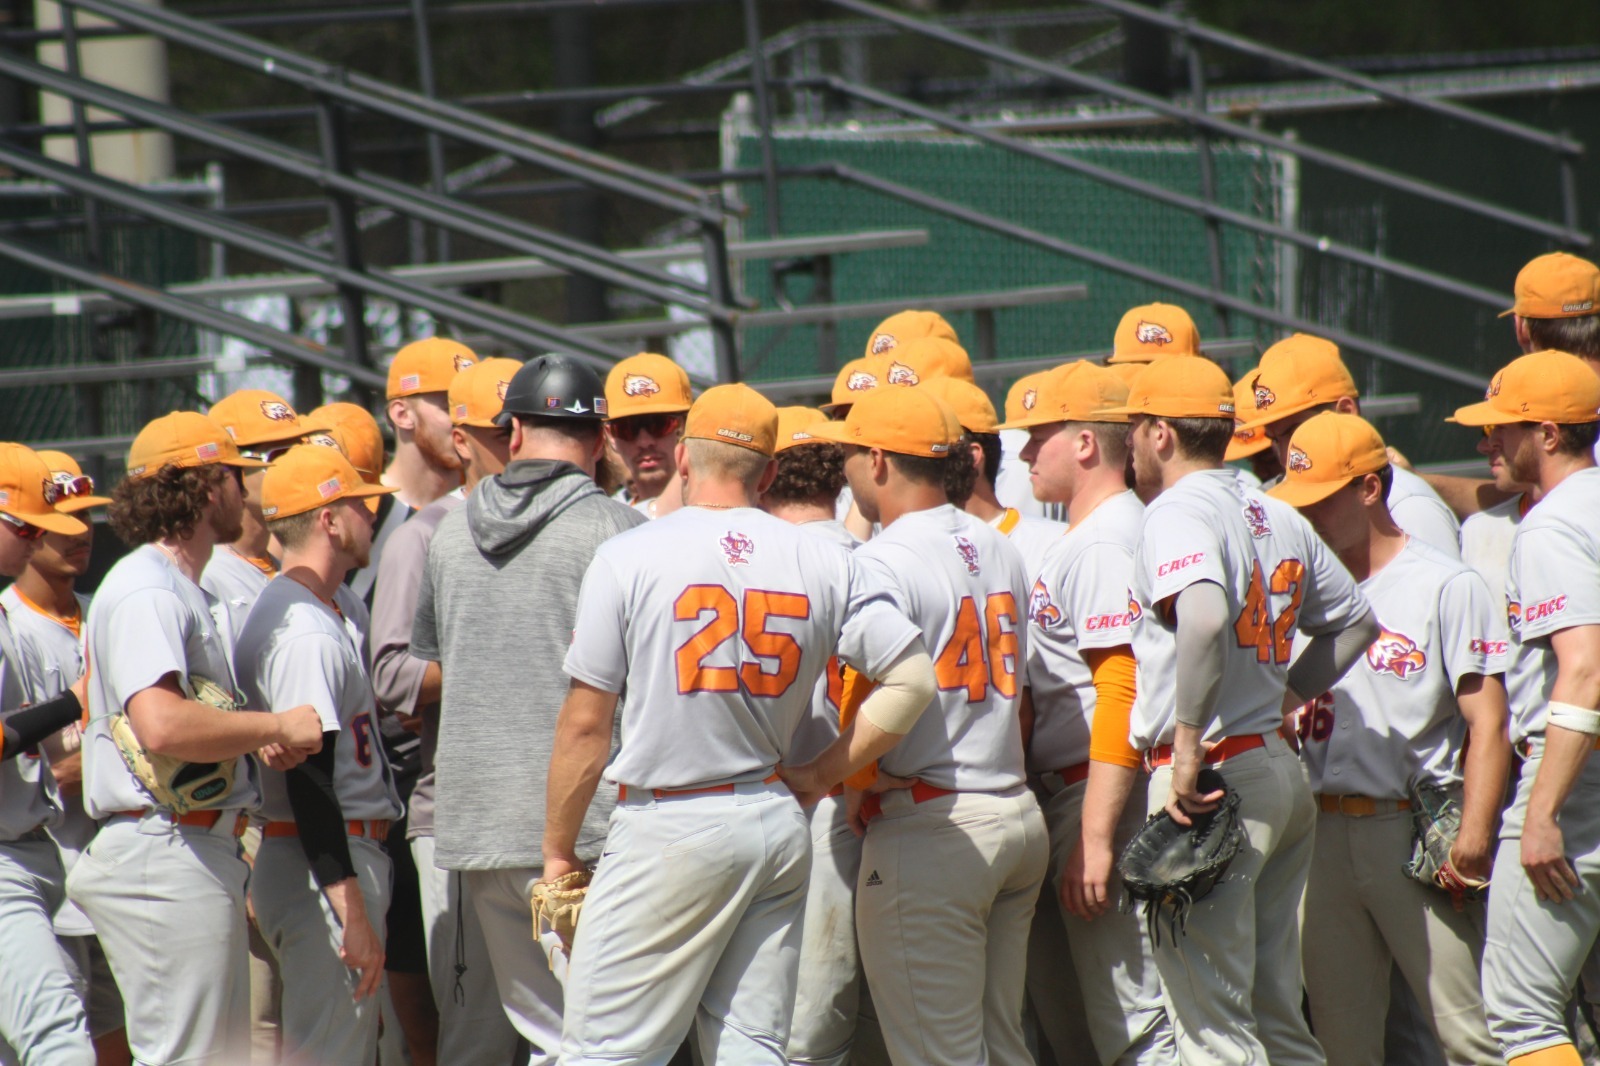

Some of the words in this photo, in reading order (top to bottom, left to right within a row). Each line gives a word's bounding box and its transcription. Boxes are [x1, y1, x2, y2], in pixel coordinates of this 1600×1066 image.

[717, 428, 753, 441] EAGLES
[1157, 552, 1204, 577] CACC
[673, 584, 810, 698] 25
[1233, 559, 1305, 665] 42
[1525, 595, 1567, 622] CACC
[933, 591, 1019, 704] 46
